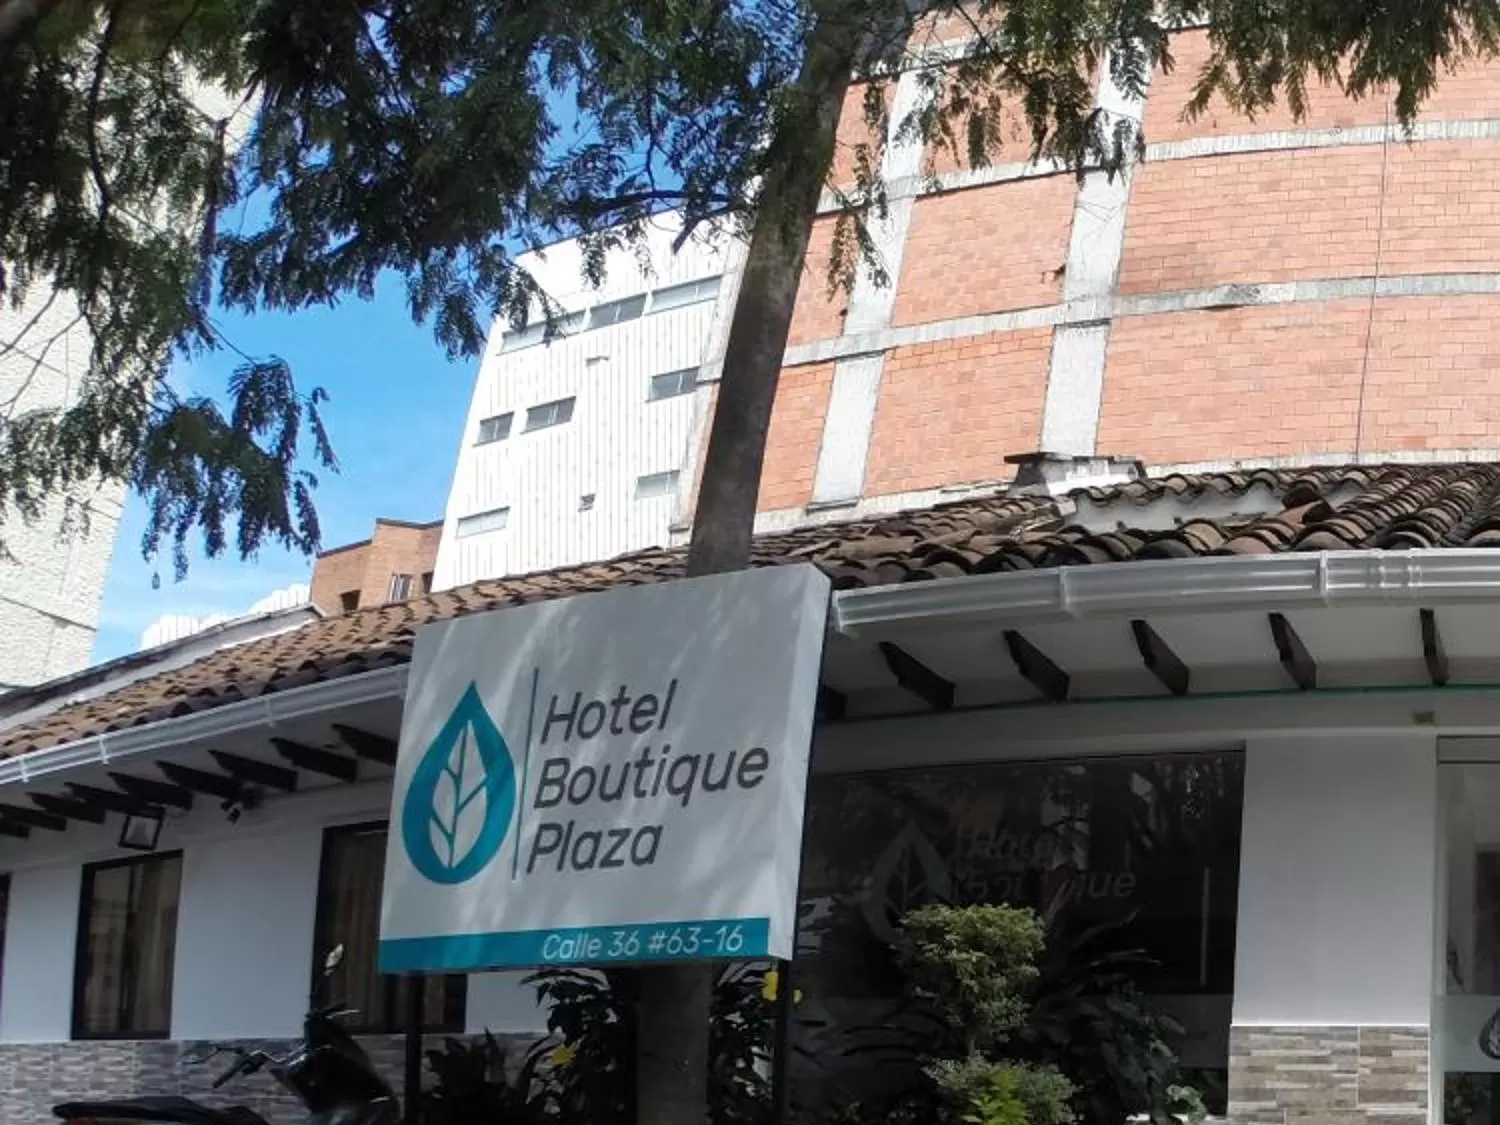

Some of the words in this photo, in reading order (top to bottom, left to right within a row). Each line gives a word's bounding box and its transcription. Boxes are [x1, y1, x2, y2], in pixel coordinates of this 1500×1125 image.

[540, 678, 678, 744] Hotel
[533, 744, 769, 808] Boutique
[526, 820, 664, 875] Plaza
[542, 928, 600, 960] Calle
[607, 929, 640, 957] 36
[648, 924, 744, 956] #63-16
